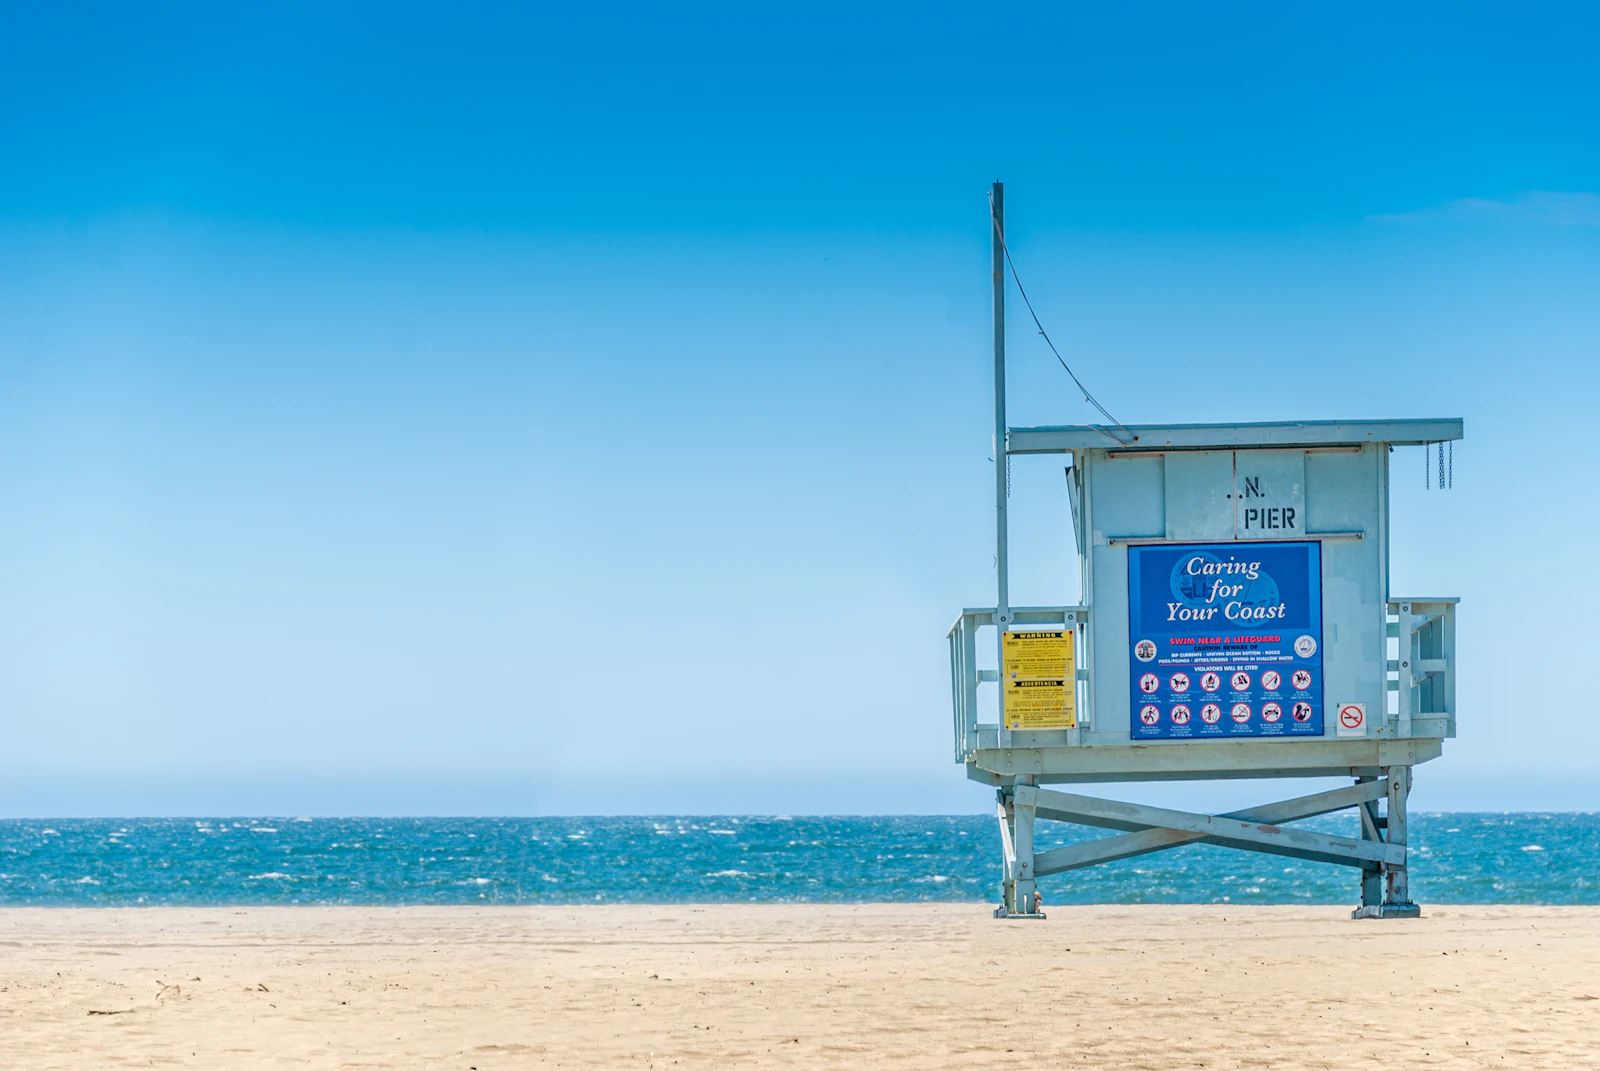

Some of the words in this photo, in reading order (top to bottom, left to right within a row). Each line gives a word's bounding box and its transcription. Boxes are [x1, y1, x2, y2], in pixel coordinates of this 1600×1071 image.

[1245, 476, 1265, 498] N.
[1245, 507, 1296, 530] PIER
[1186, 556, 1260, 580] Caring
[1205, 578, 1243, 603] for
[1166, 602, 1218, 621] Your
[1224, 601, 1286, 620] Coast
[1169, 637, 1196, 645] SWIM
[1197, 636, 1222, 645] NEAR
[1224, 636, 1231, 644] A
[1233, 635, 1281, 644] LIFEGUARD
